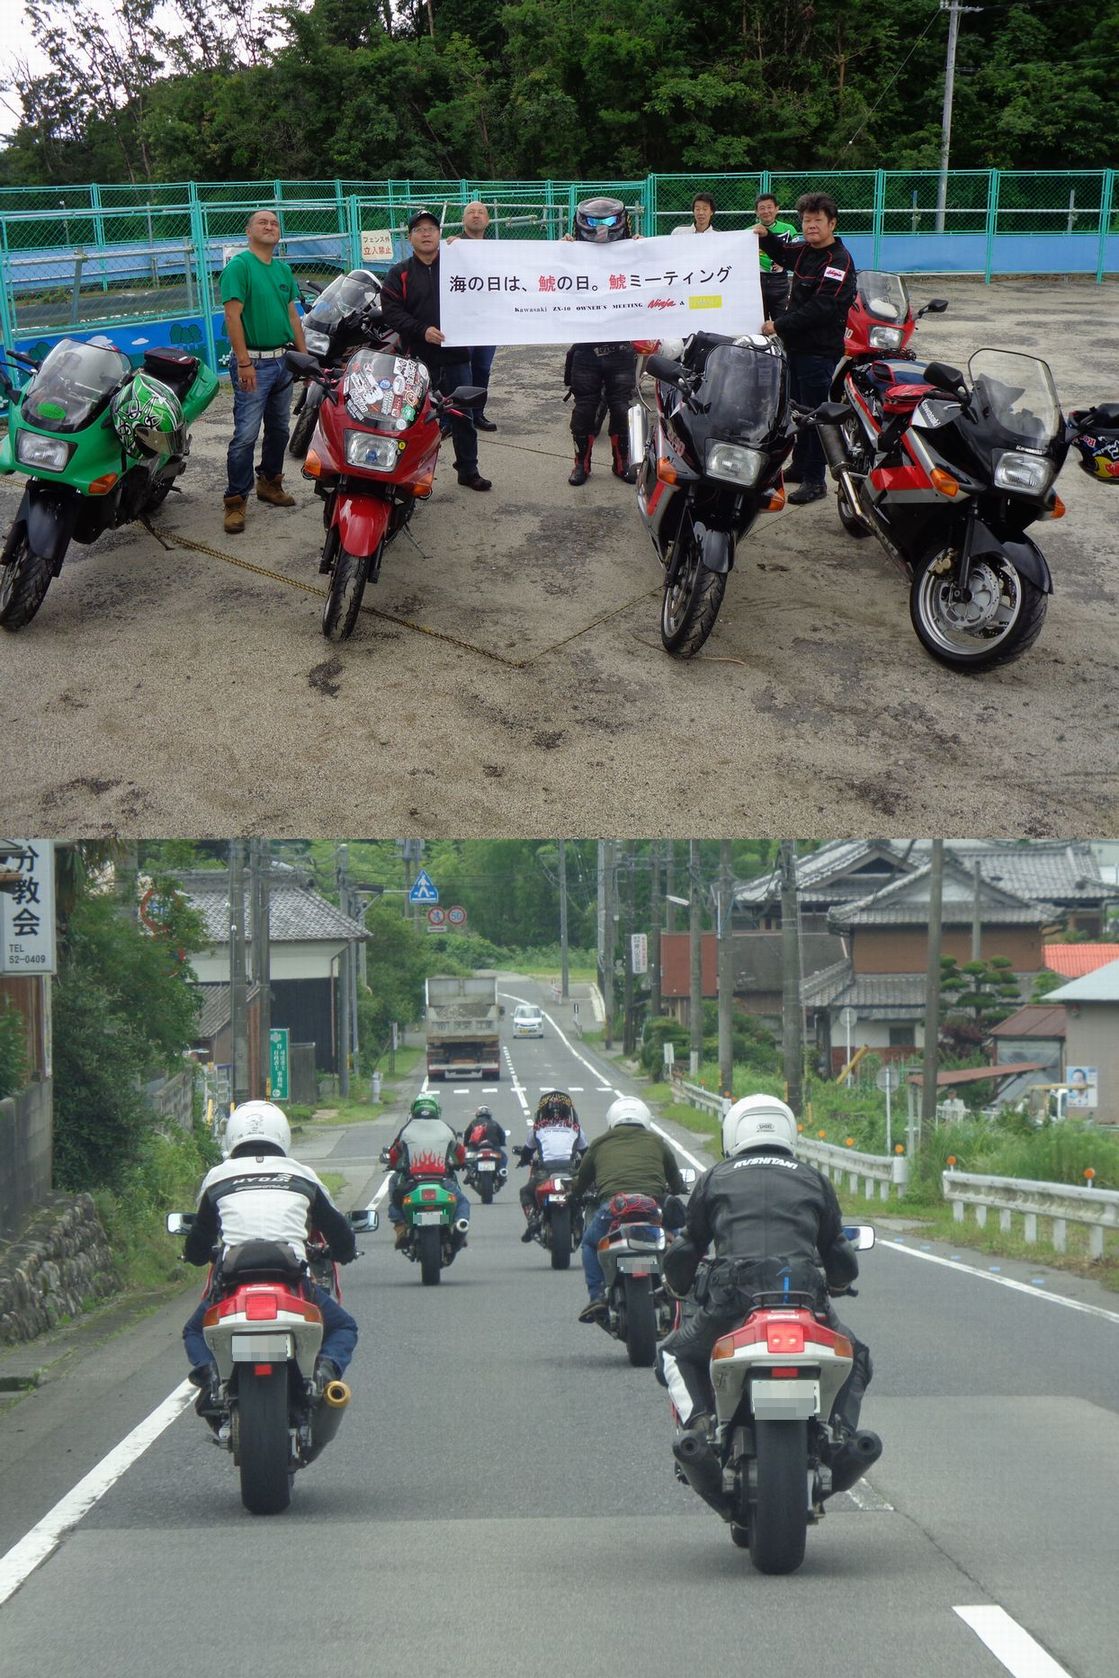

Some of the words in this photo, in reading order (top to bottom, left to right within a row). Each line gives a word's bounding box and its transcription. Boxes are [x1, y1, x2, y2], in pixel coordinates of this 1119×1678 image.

[363, 246, 392, 255] 立入禁止
[647, 298, 676, 311] Ninja
[9, 944, 24, 952] TEL
[9, 955, 46, 964] 52-0409
